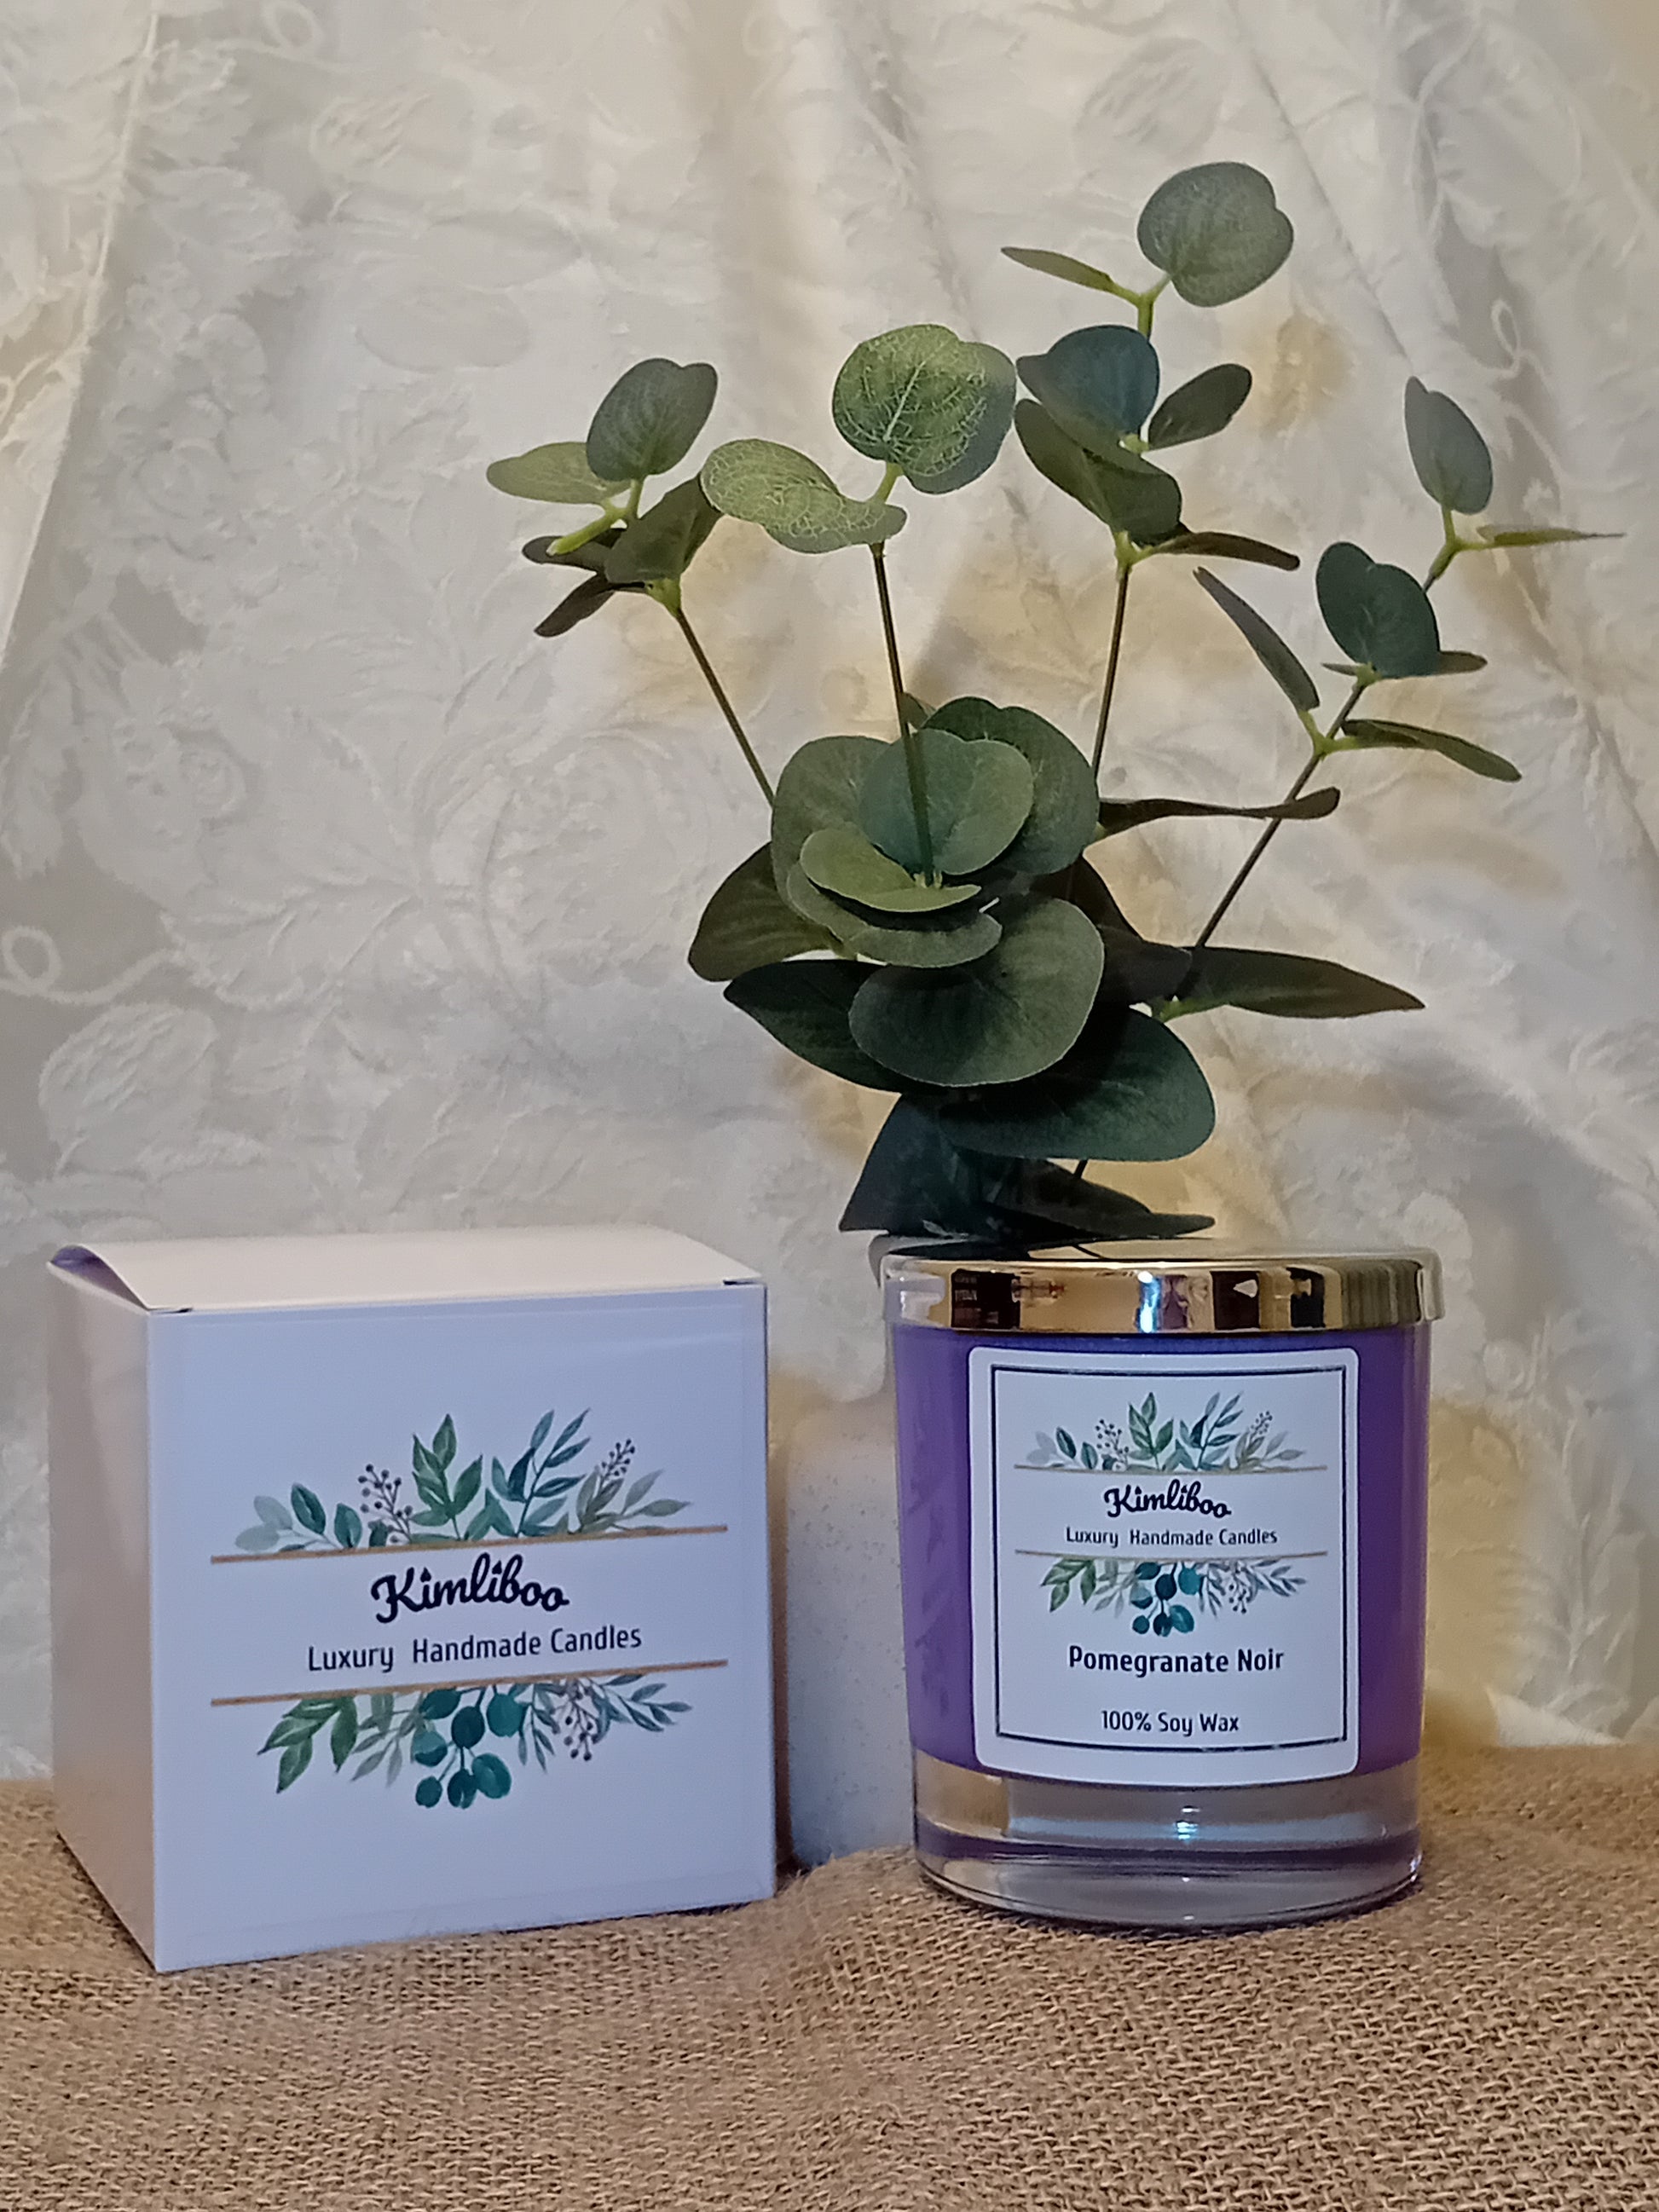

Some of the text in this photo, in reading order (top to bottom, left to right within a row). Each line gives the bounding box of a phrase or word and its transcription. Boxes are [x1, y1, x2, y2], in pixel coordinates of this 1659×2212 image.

[1103, 1479, 1232, 1518] Kimliboo
[1066, 1527, 1278, 1548] Luxury Handmade Candles
[371, 1552, 569, 1623] Kimliboo
[308, 1625, 642, 1673] Luxury Handmade Candles
[1069, 1646, 1285, 1678] Pomegranate Noir
[1101, 1710, 1240, 1737] 100% Soy Wax
